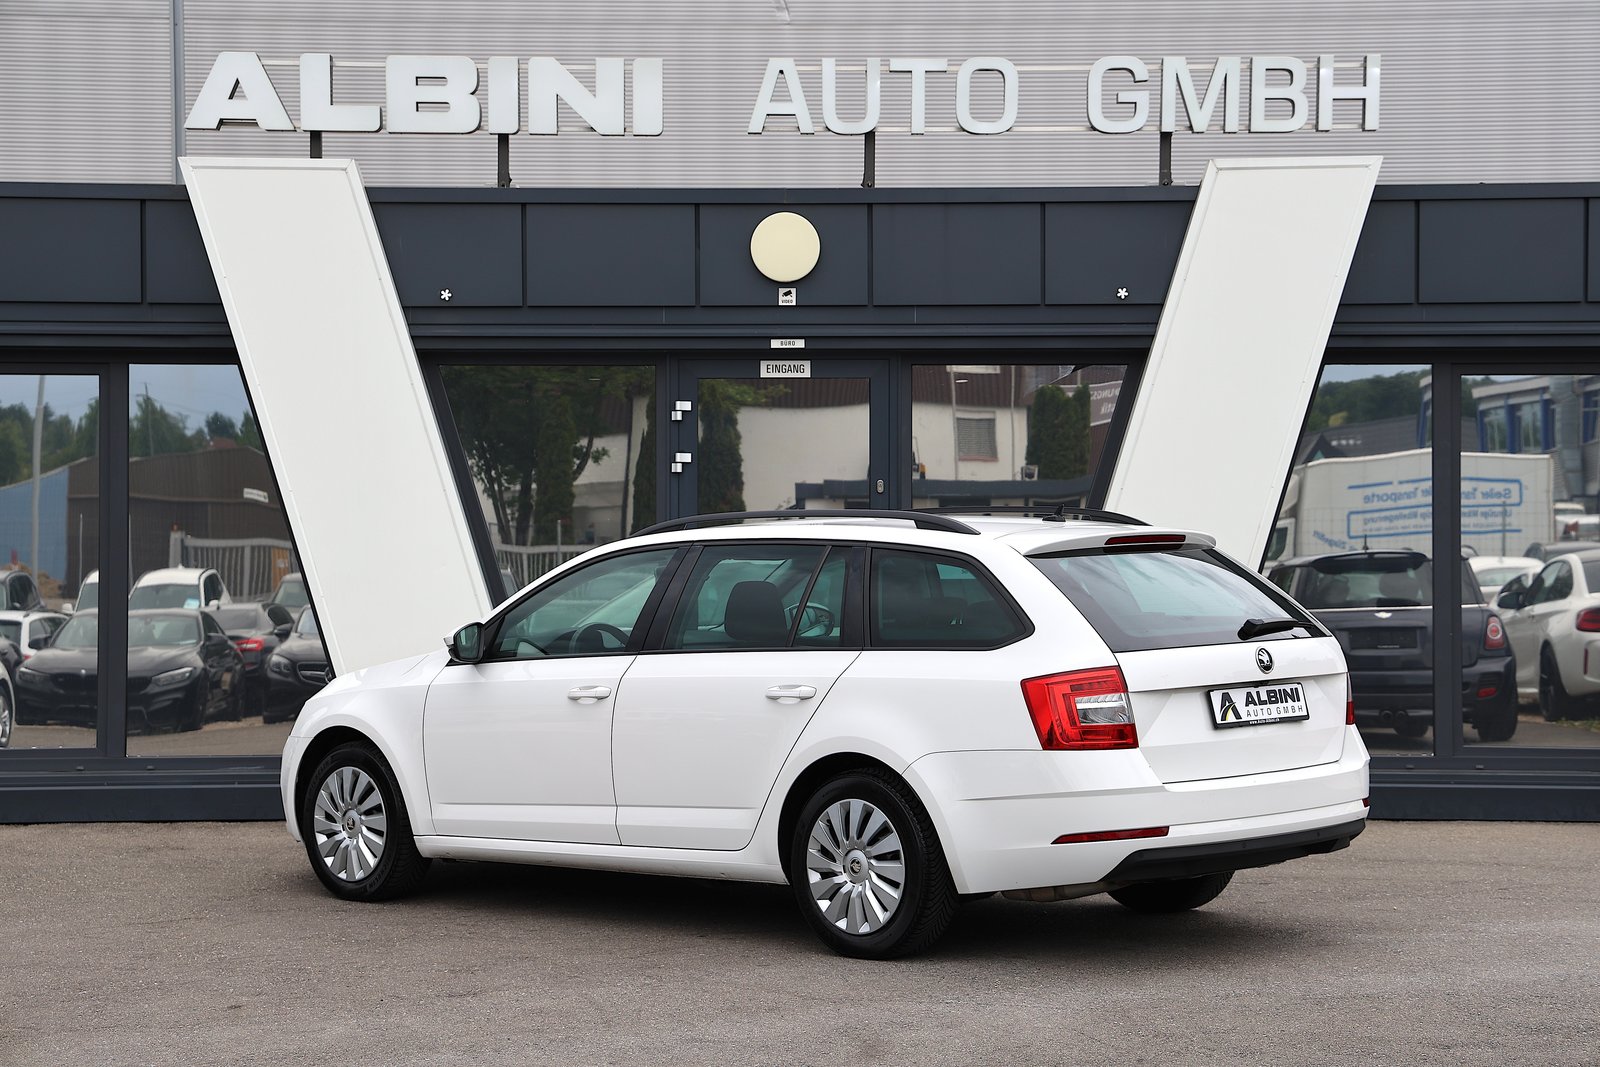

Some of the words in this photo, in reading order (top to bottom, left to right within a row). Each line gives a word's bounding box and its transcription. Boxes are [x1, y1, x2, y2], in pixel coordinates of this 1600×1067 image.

[184, 51, 664, 136] ALBINI
[747, 56, 1020, 136] AUTO
[1087, 53, 1383, 134] GMBH
[766, 364, 805, 374] EINGANG
[1245, 687, 1301, 707] ALBINI
[1246, 707, 1272, 718] AUTO
[1276, 705, 1304, 715] GMBH
